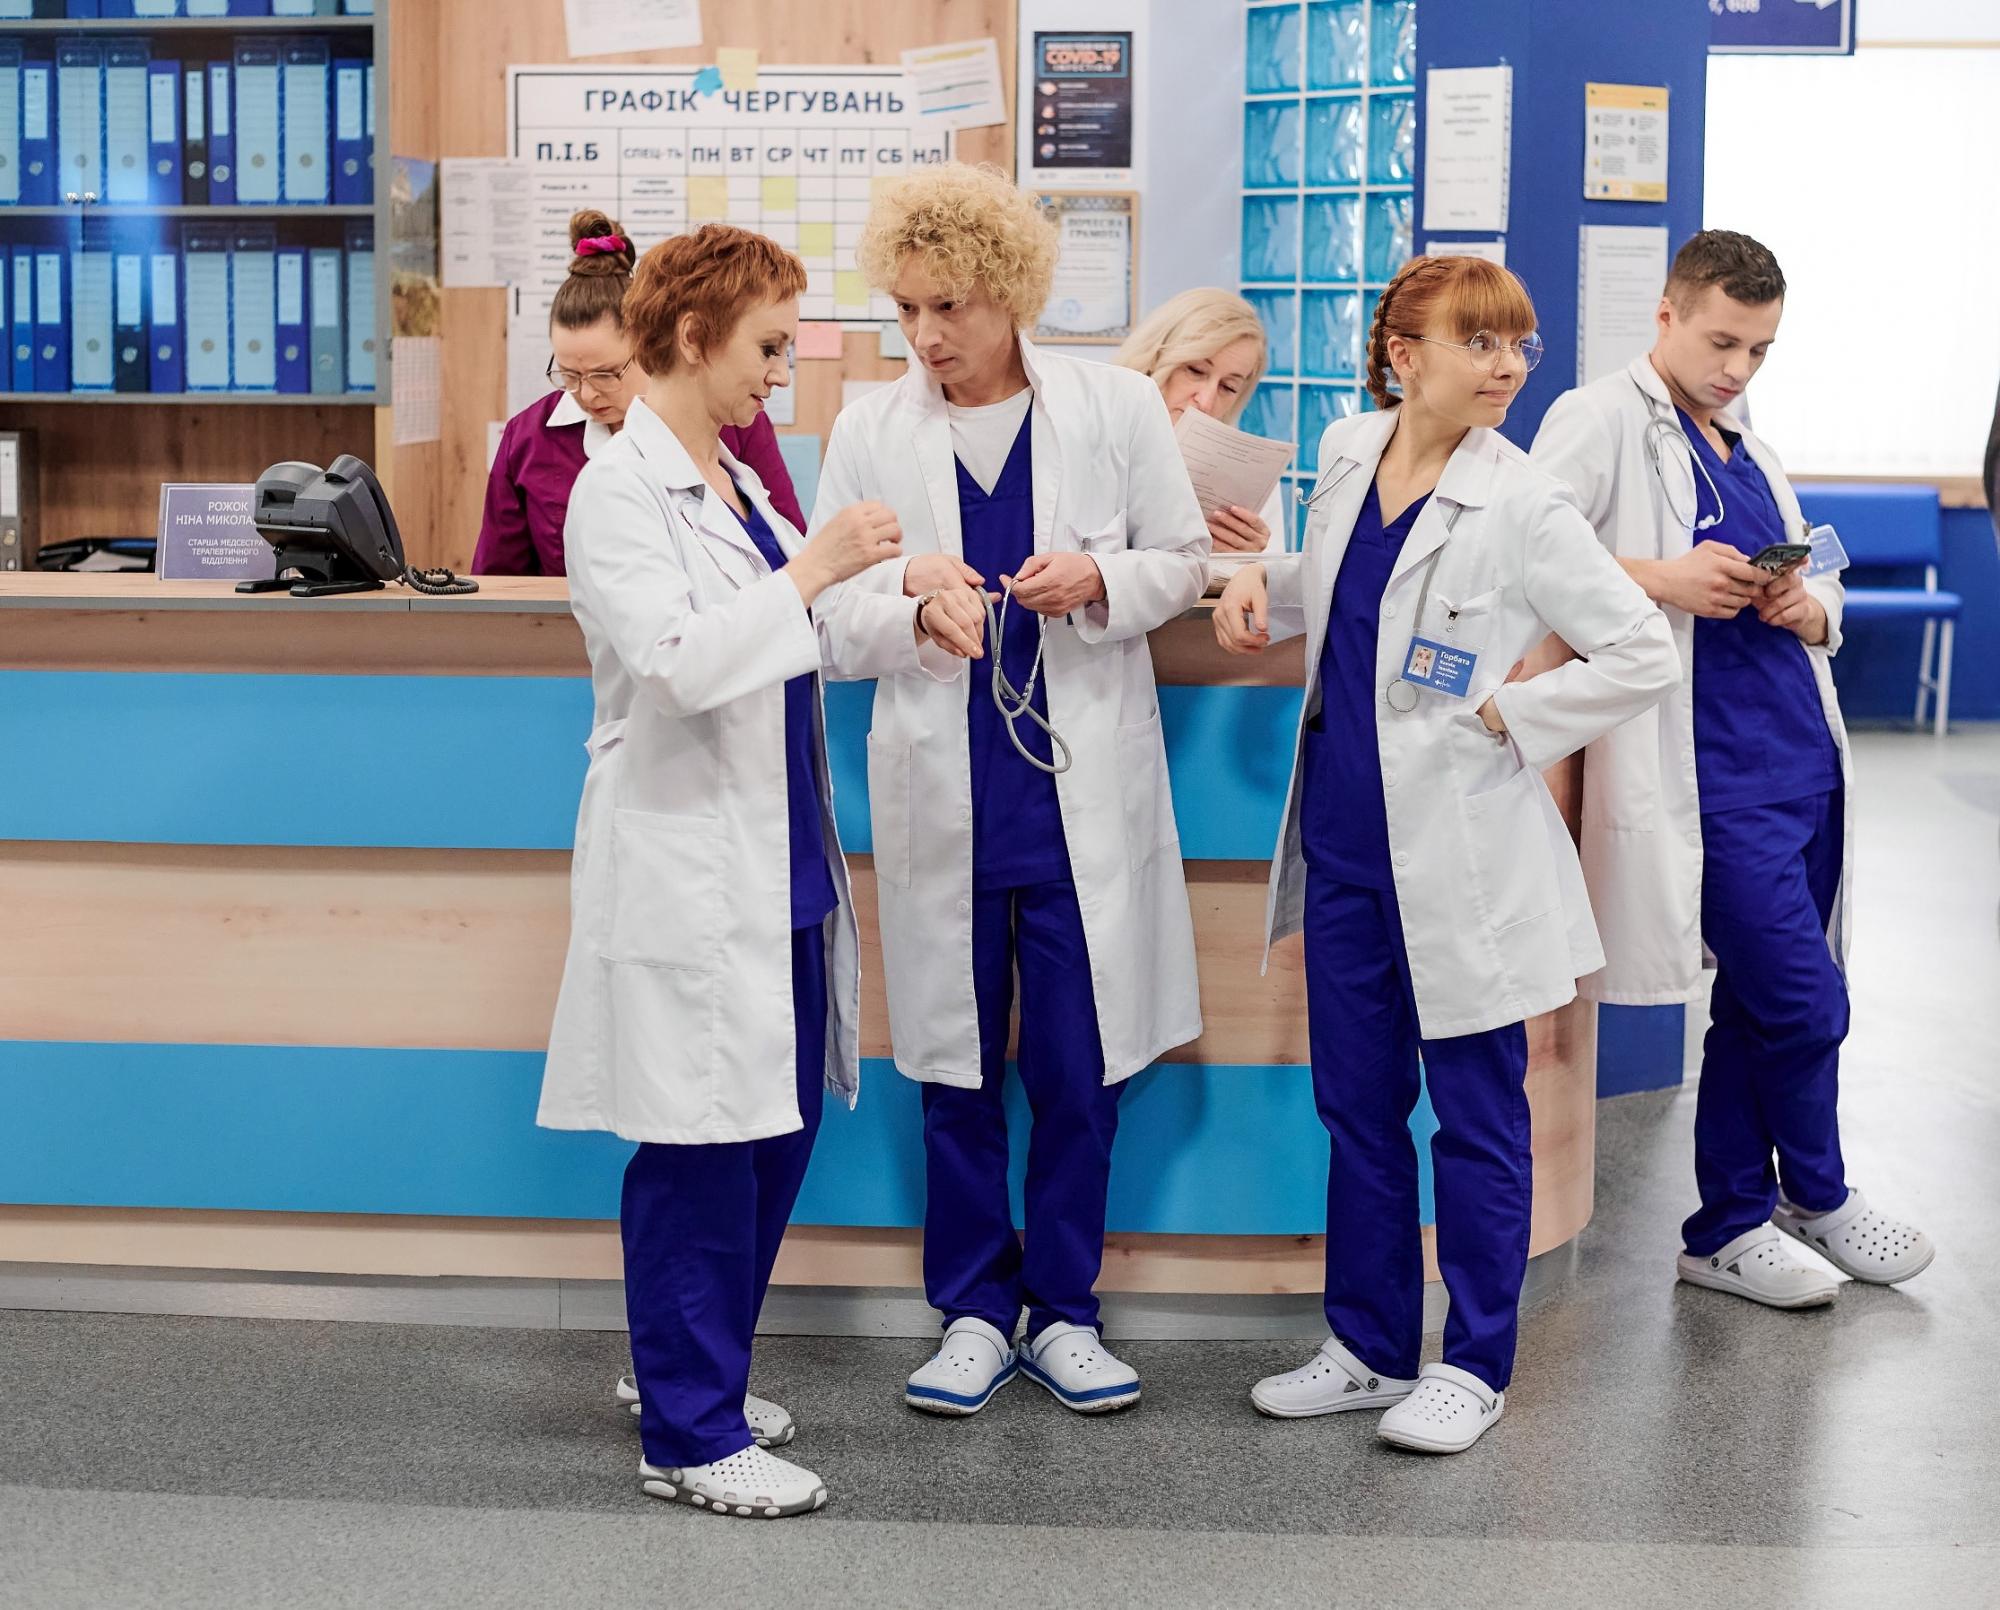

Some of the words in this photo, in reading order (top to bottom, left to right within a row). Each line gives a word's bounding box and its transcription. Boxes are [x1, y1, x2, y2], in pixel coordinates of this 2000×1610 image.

[585, 90, 698, 112] ГРАФІК
[723, 91, 905, 113] ЧЕРГУВАНЬ
[537, 142, 599, 161] П.І.Б
[691, 147, 721, 162] ПН
[731, 147, 755, 162] ВТ
[767, 147, 793, 162] СР
[803, 148, 829, 162] ЧТ
[840, 148, 866, 163] ПТ
[876, 148, 903, 163] СБ
[208, 501, 248, 512] РОЖОК
[176, 514, 203, 525] НІНА
[206, 514, 257, 525] МИКОЛА
[188, 539, 219, 547] СТАРША
[220, 539, 264, 547] МЕДСЕСТРА
[191, 547, 259, 556] ТЕРАПЕВТИЧНОГО
[201, 557, 248, 565] ВІДДІЛЕННЯ
[1440, 651, 1470, 665] Горбата
